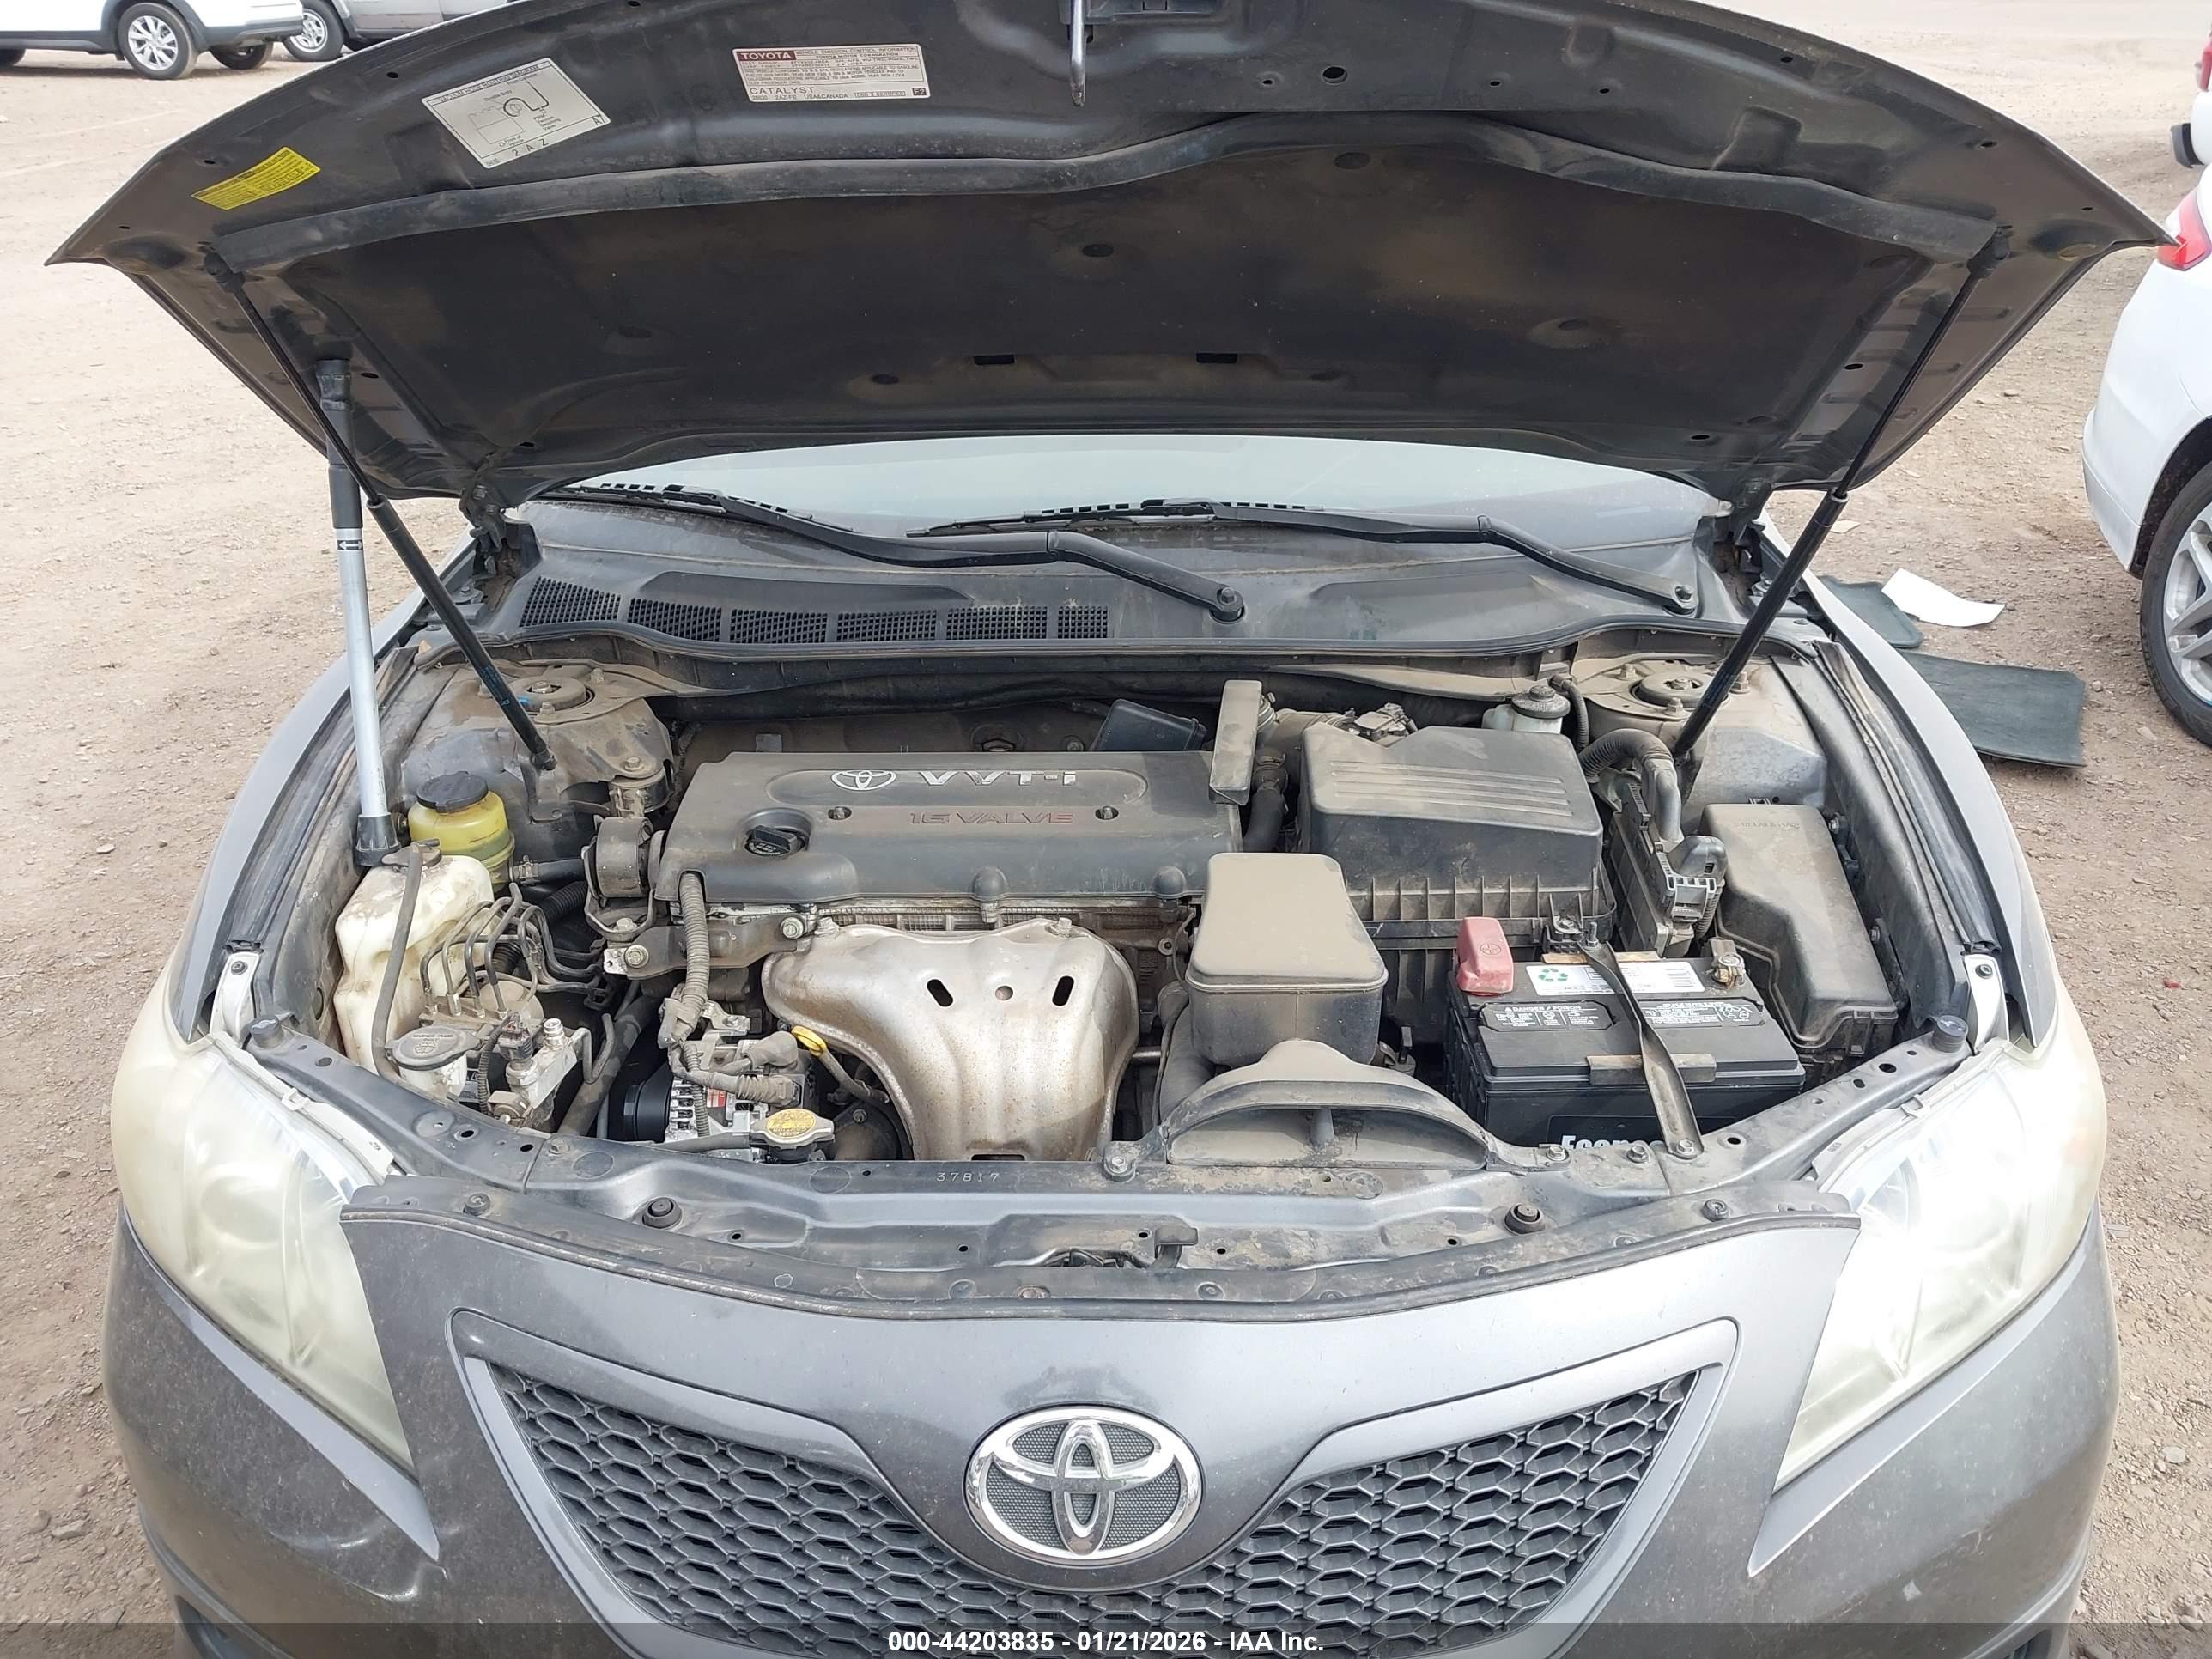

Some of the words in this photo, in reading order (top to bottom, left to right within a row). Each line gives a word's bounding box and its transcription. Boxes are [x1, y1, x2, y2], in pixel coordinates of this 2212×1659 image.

[918, 771, 1075, 787] VVT-i
[956, 812, 1073, 824] VALVE
[936, 1172, 1000, 1182] 37817
